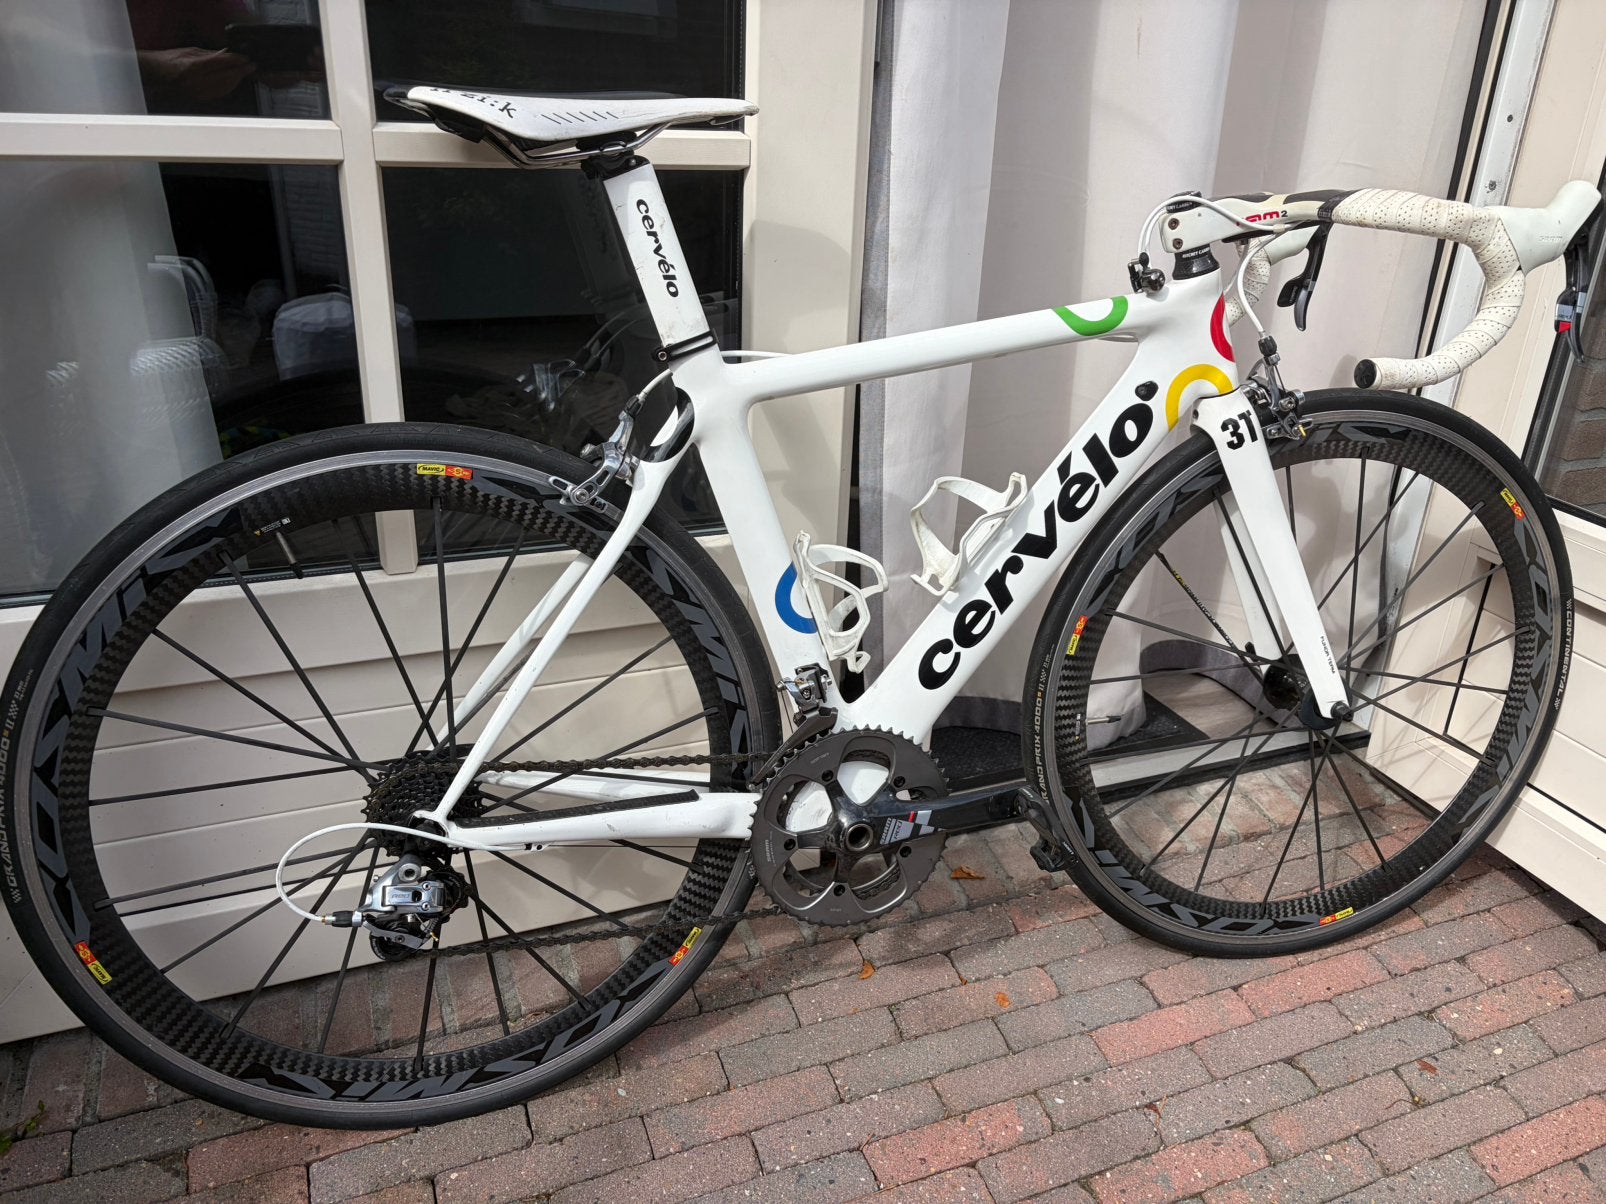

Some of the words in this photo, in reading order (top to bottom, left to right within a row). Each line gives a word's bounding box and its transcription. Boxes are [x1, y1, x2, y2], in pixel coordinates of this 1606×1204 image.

[636, 199, 679, 298] cervélo
[1220, 409, 1258, 450] 3T
[918, 402, 1153, 691] cervélo
[1553, 610, 1573, 701] CONTINENTAL
[1036, 763, 1050, 805] RAND
